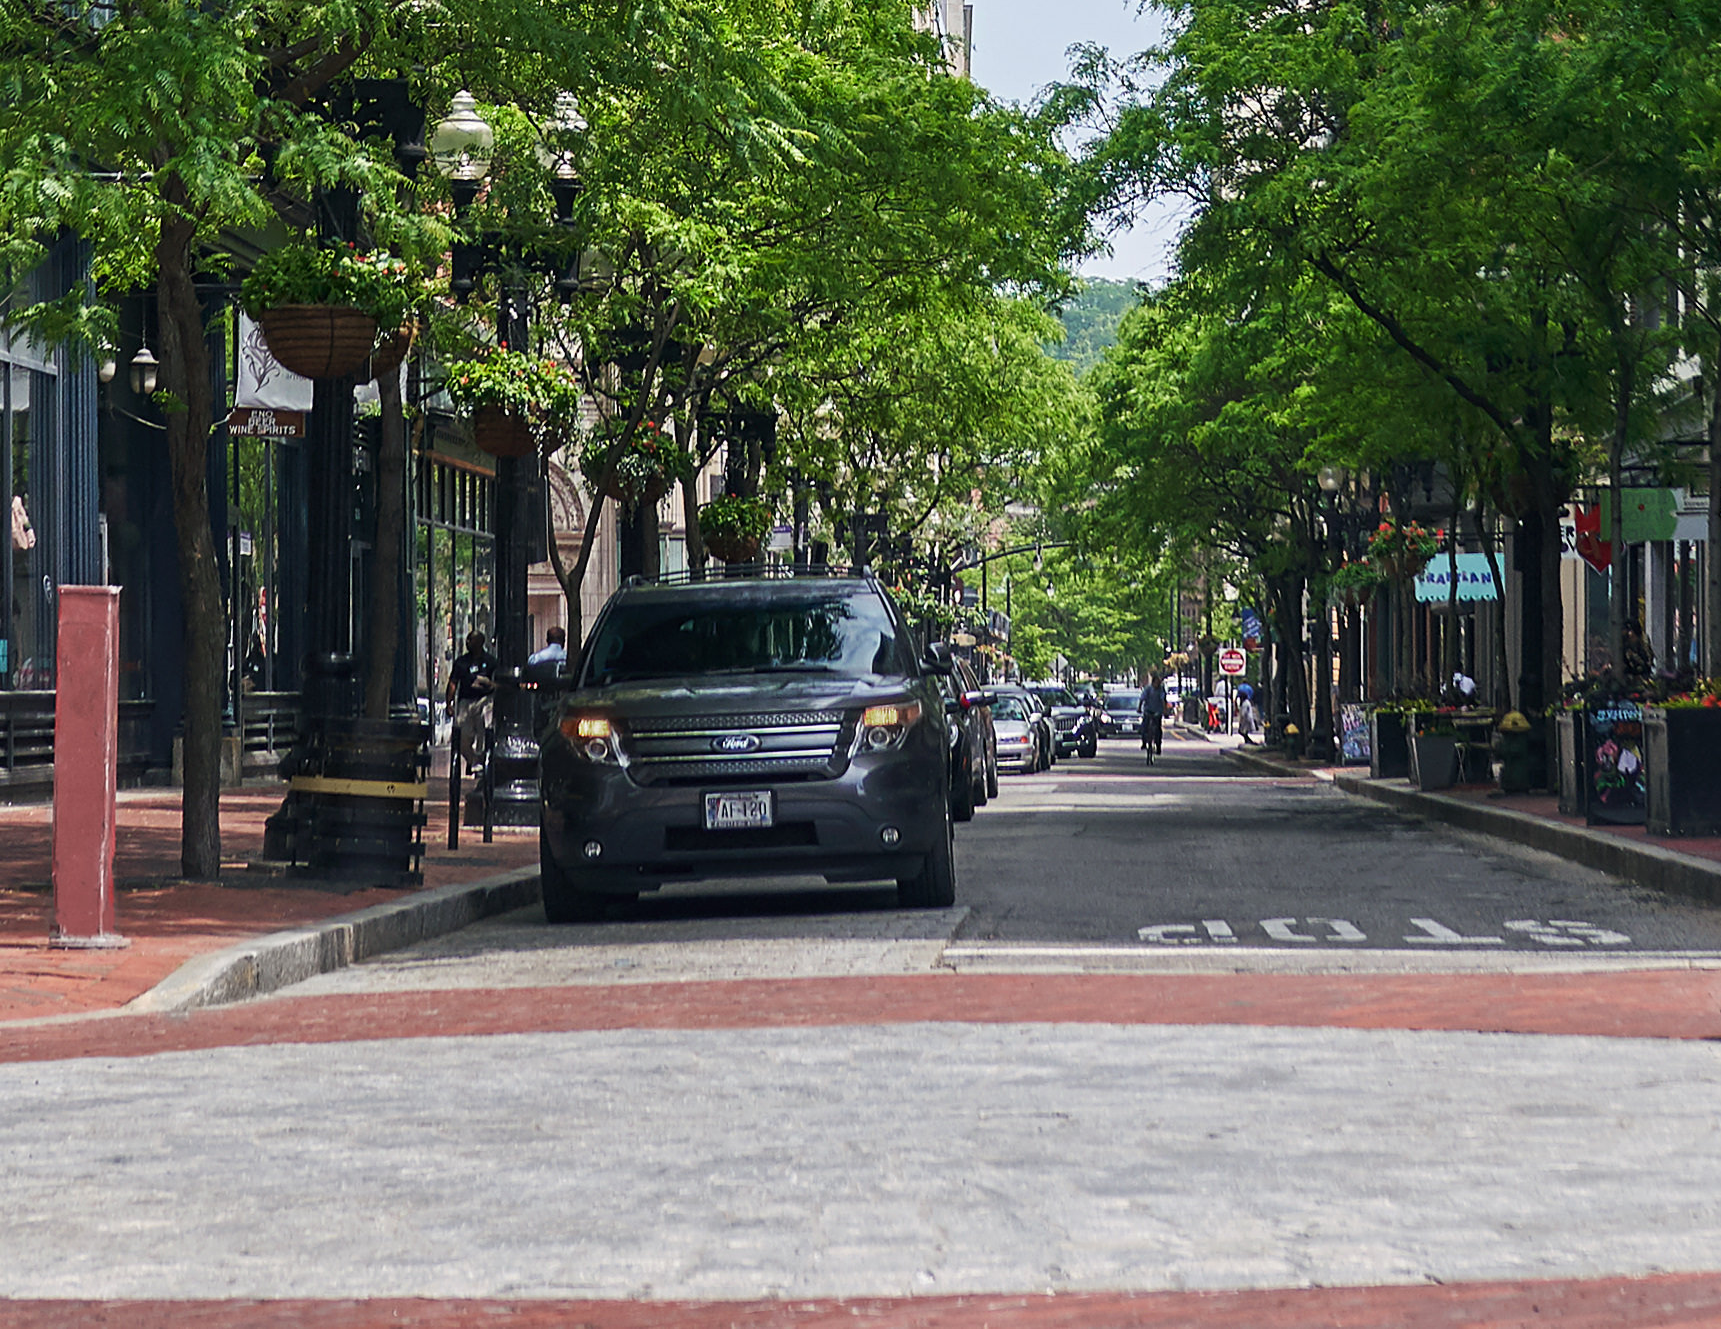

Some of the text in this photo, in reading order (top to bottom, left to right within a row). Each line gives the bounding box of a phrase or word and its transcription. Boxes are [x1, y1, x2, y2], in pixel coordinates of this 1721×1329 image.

[229, 425, 296, 435] WINE SPIRITS
[1421, 570, 1494, 585] RALAN
[1137, 917, 1632, 945] STOP
